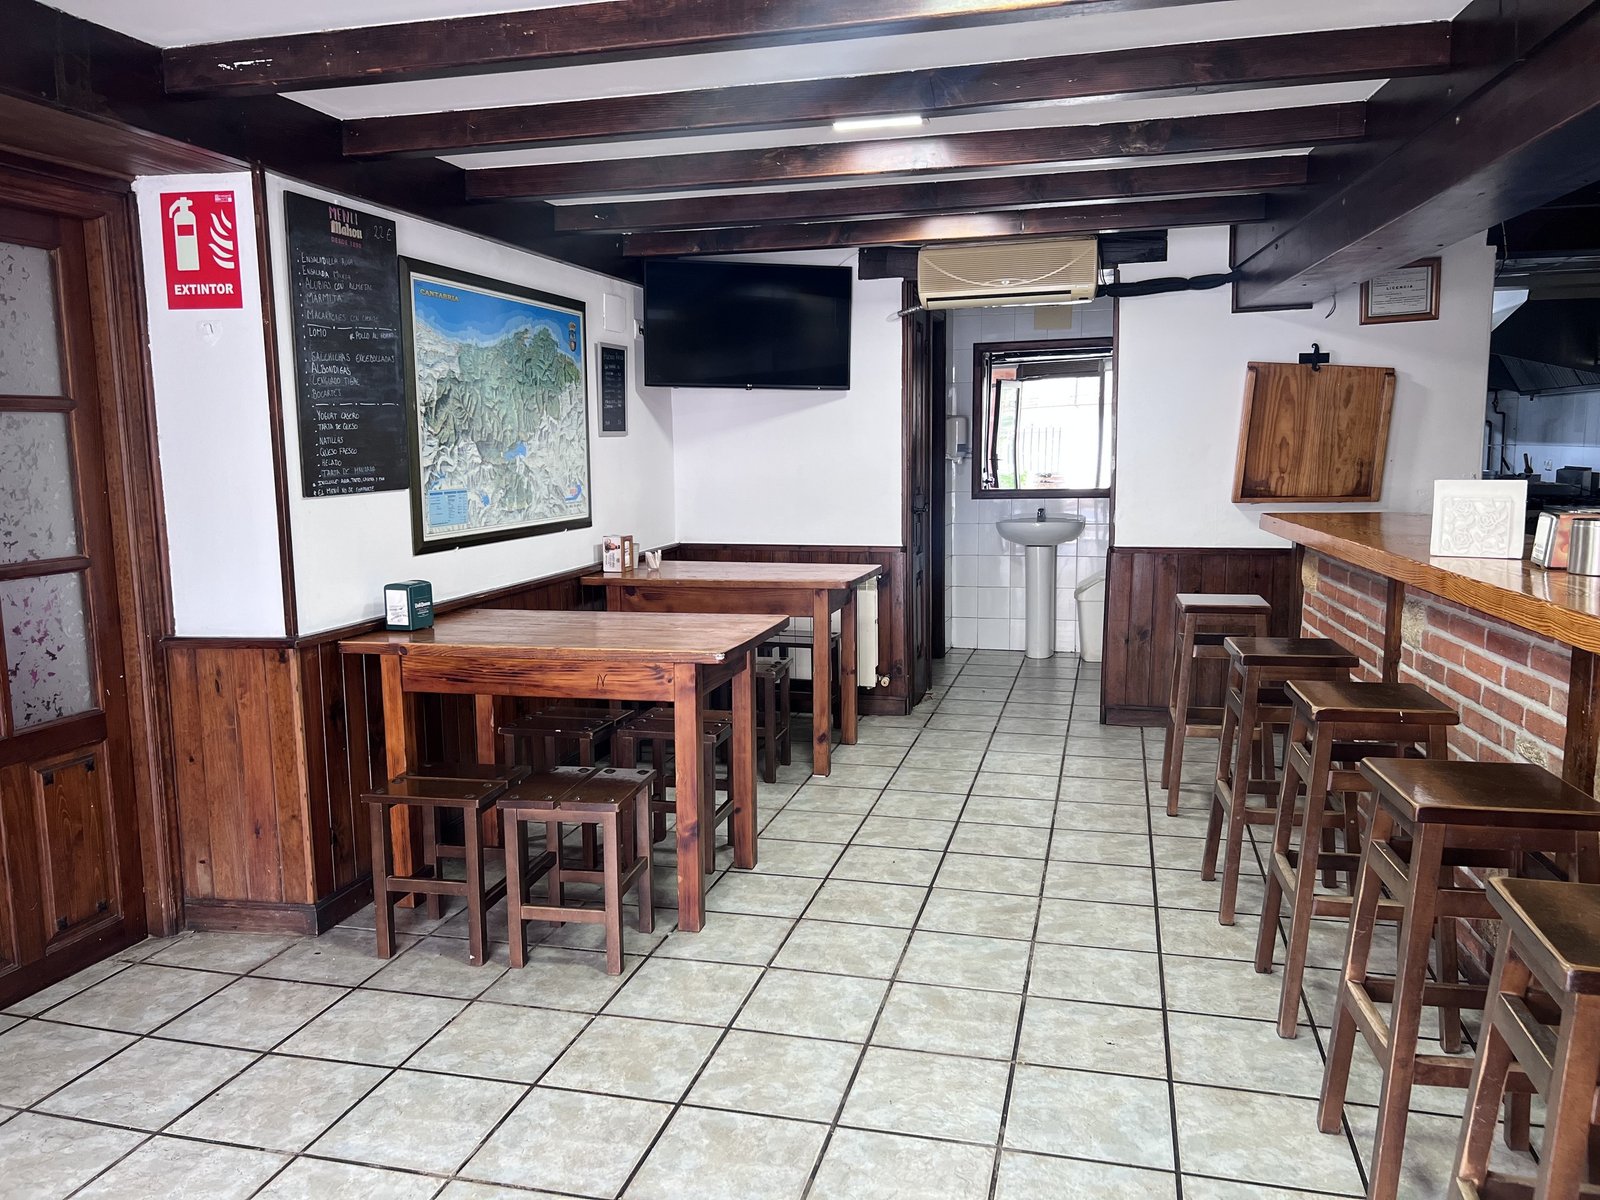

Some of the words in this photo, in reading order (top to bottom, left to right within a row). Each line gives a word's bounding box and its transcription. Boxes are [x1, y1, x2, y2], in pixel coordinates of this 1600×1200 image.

[330, 219, 364, 240] Mahou
[174, 283, 235, 296] EXTINTOR
[420, 288, 460, 303] CANTABRIA
[308, 327, 327, 338] LOMO
